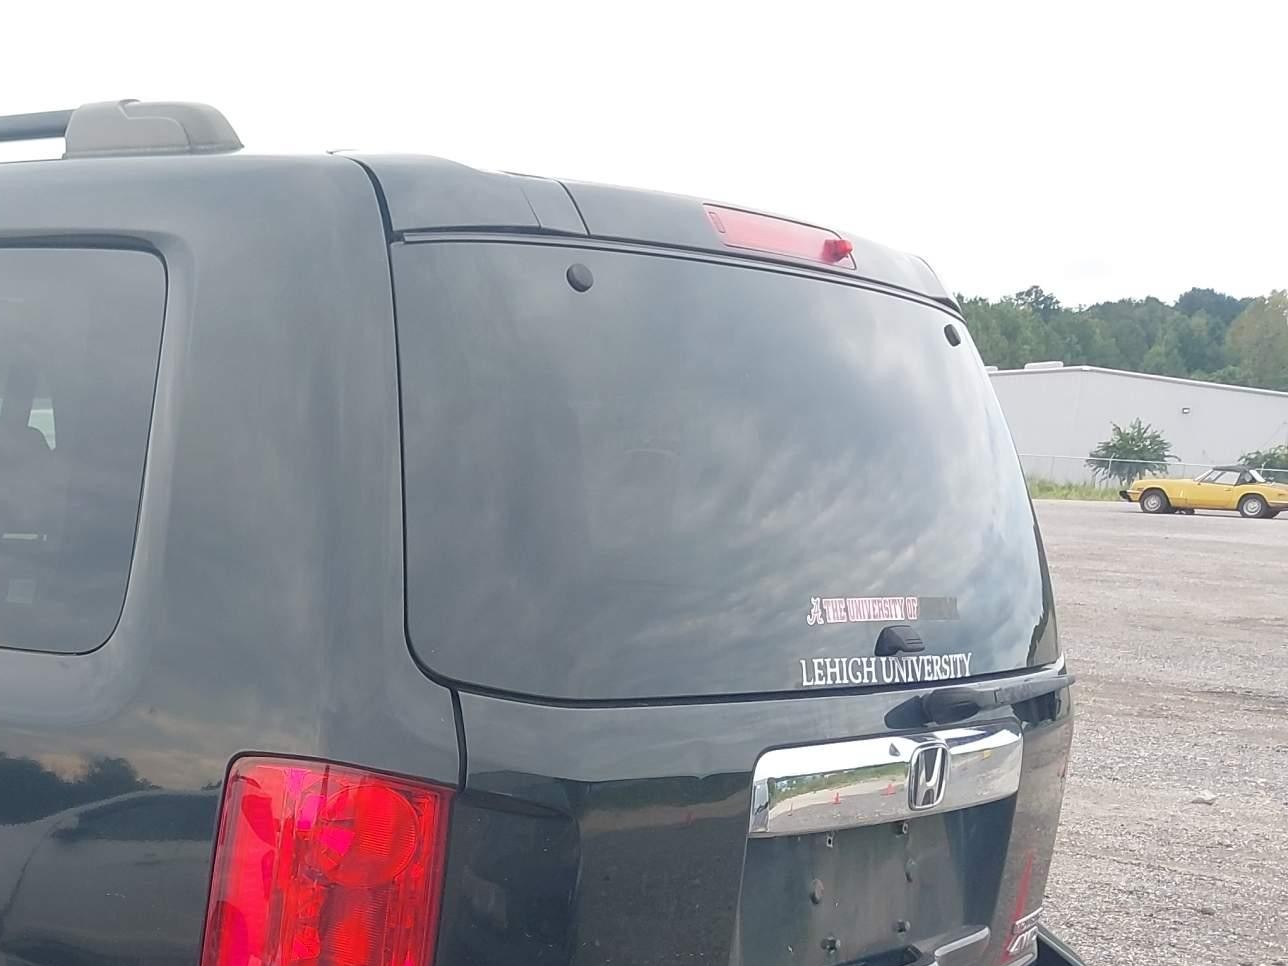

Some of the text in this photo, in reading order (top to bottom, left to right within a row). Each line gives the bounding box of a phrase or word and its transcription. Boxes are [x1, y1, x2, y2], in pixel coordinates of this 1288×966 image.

[823, 599, 847, 623] THE
[847, 597, 905, 622] UNIVERSITY
[906, 597, 918, 620] OF
[800, 653, 972, 686] LEHIGH UNIVERSITY
